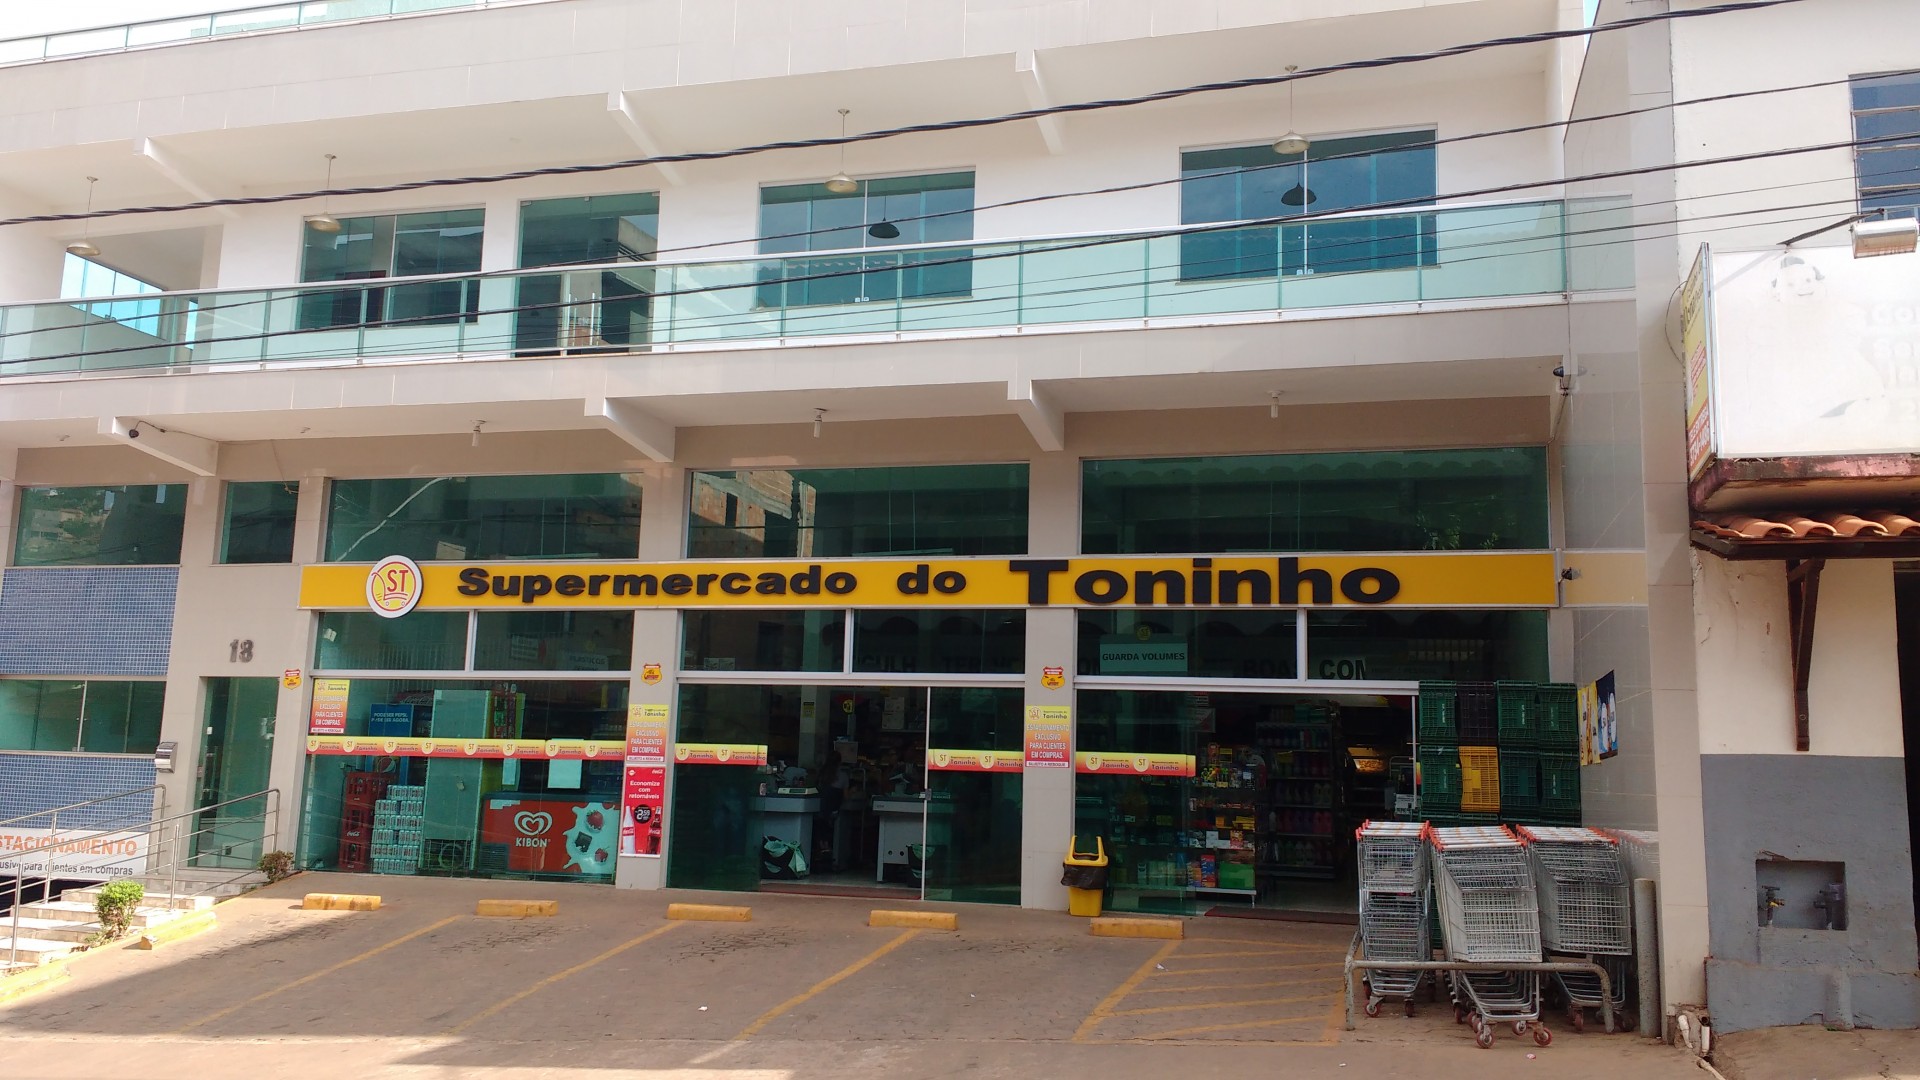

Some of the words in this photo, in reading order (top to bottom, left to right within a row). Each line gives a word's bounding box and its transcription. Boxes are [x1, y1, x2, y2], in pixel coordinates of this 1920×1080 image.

[387, 569, 408, 592] ST
[457, 565, 857, 604] Supermercado
[896, 564, 966, 595] do
[1009, 557, 1400, 605] Toninho
[1102, 653, 1139, 661] GUARDA
[0, 834, 138, 856] TACIONAMENTO
[515, 838, 548, 847] KIBON
[24, 862, 42, 872] para
[95, 866, 133, 876] compras
